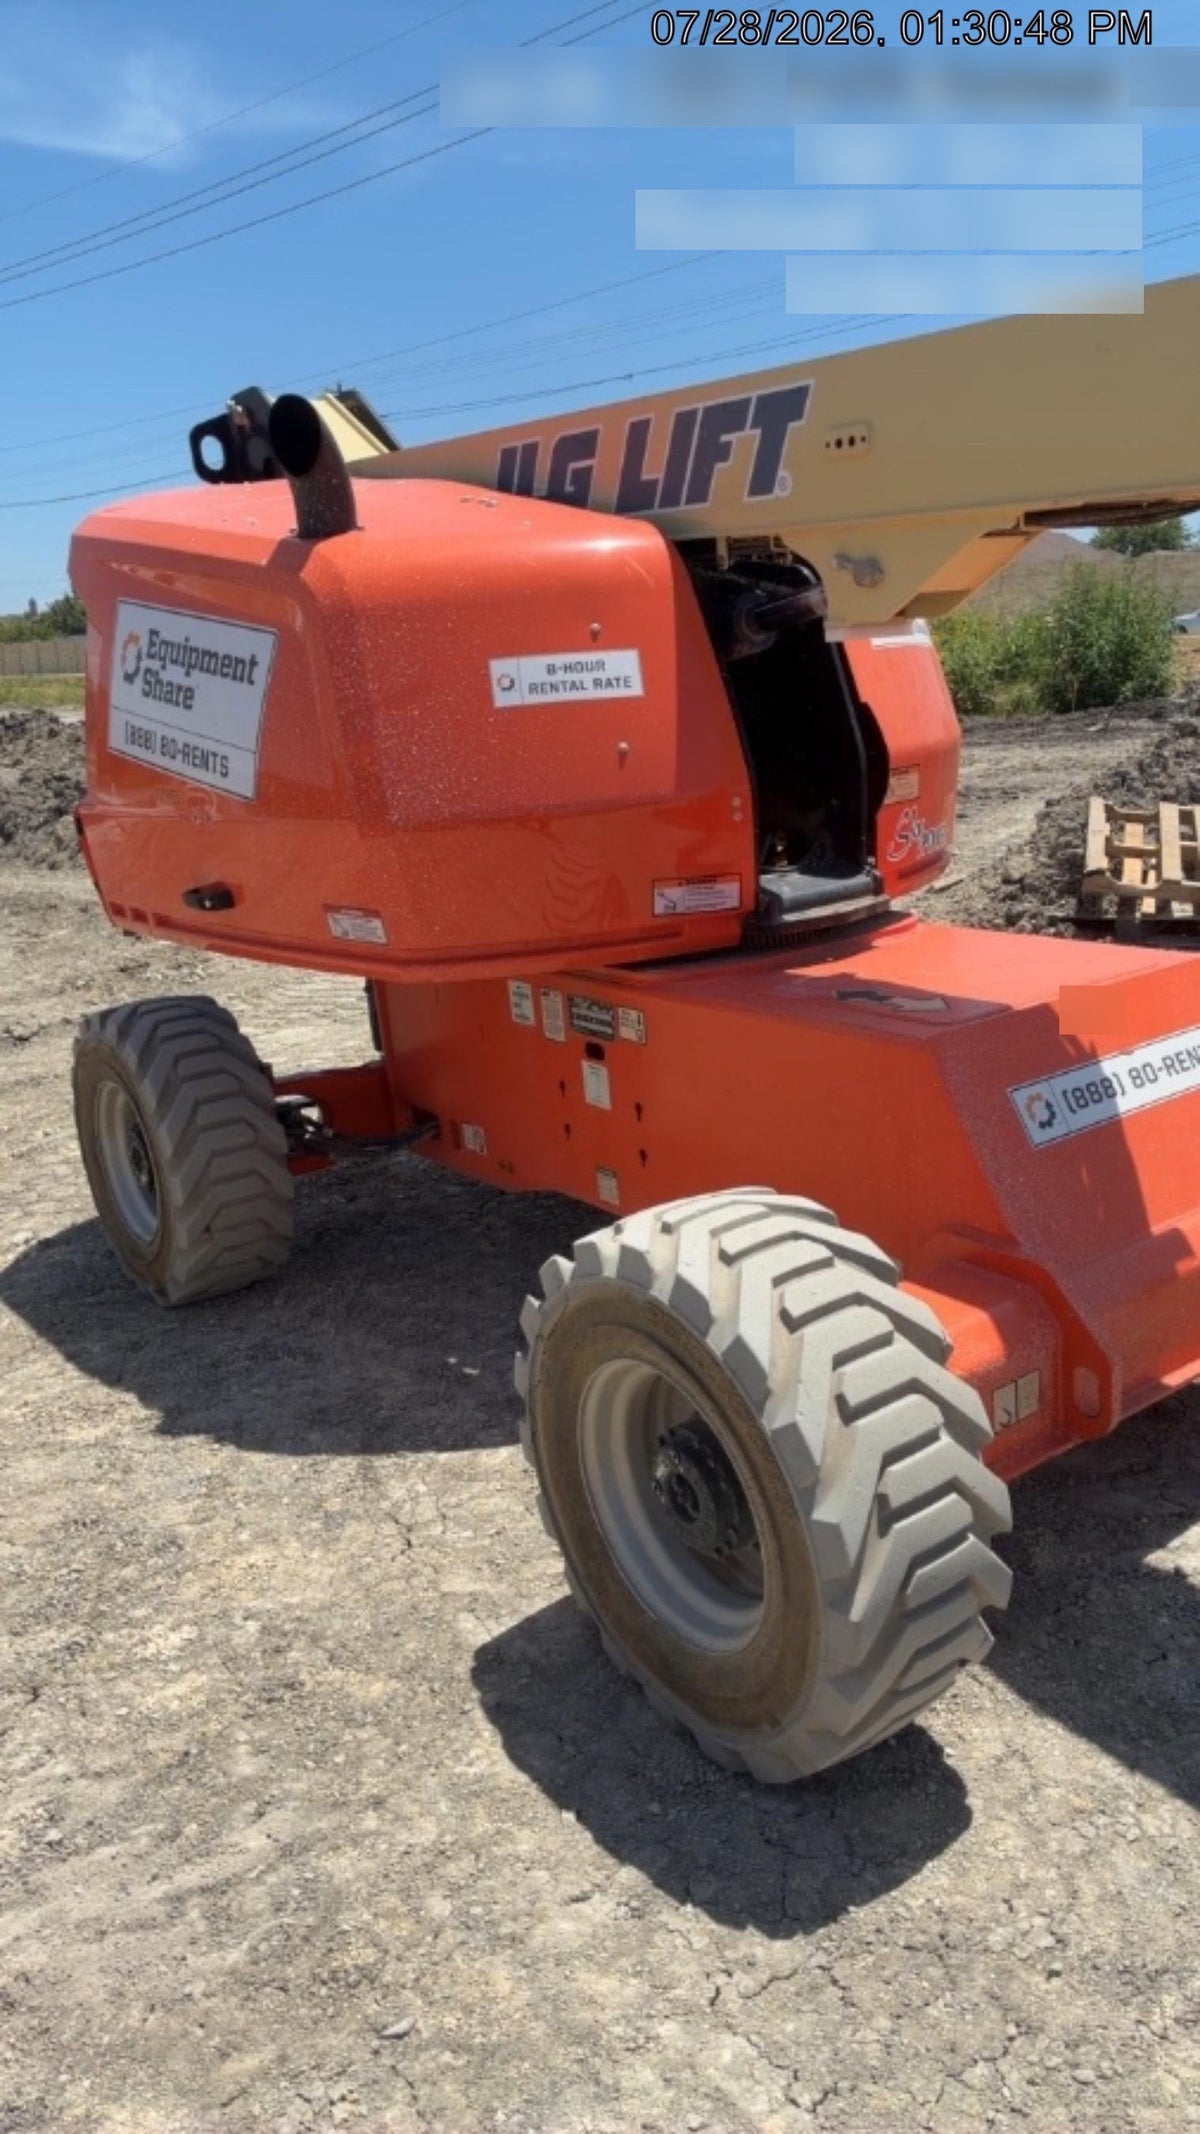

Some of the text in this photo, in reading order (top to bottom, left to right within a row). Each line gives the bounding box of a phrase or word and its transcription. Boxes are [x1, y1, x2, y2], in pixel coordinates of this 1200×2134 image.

[613, 379, 815, 515] LIFT
[146, 627, 259, 686] Equipment
[546, 659, 606, 676] 8-HOUR
[142, 667, 195, 710] Share
[528, 675, 632, 695] RENTAL RATE
[161, 735, 230, 778] 80-RENTS
[1062, 1045, 1200, 1115] (888) 80-REN
